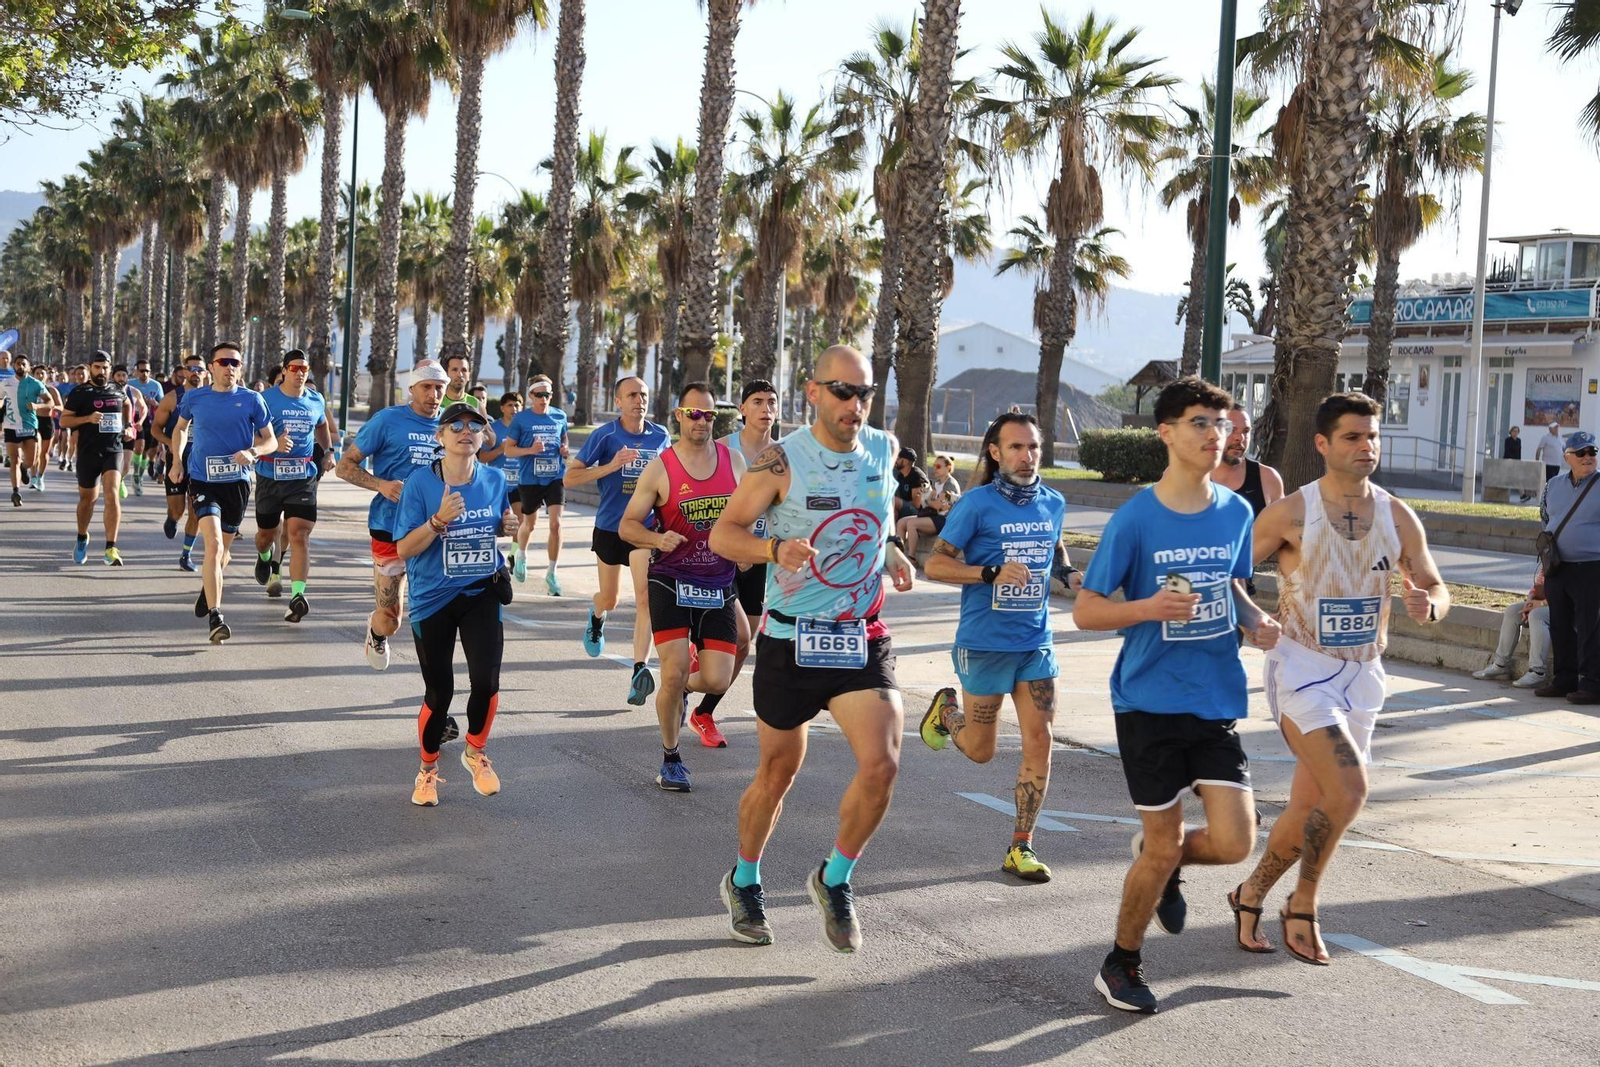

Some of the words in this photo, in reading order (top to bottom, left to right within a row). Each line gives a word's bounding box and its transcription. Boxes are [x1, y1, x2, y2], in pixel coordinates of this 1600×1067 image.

[1395, 298, 1474, 321] ROCAMAR
[1398, 345, 1434, 355] ROCAMAR
[1535, 374, 1573, 383] ROCAMAR
[211, 464, 238, 473] 1817
[278, 466, 302, 474] 1641
[631, 460, 649, 469] 192
[1000, 519, 1054, 535] mayoral
[451, 551, 491, 563] 1773
[1153, 544, 1231, 564] mayoral
[682, 585, 718, 598] 1569
[1000, 585, 1040, 597] 2042
[1326, 616, 1375, 631] 1884
[806, 636, 859, 651] 1669
